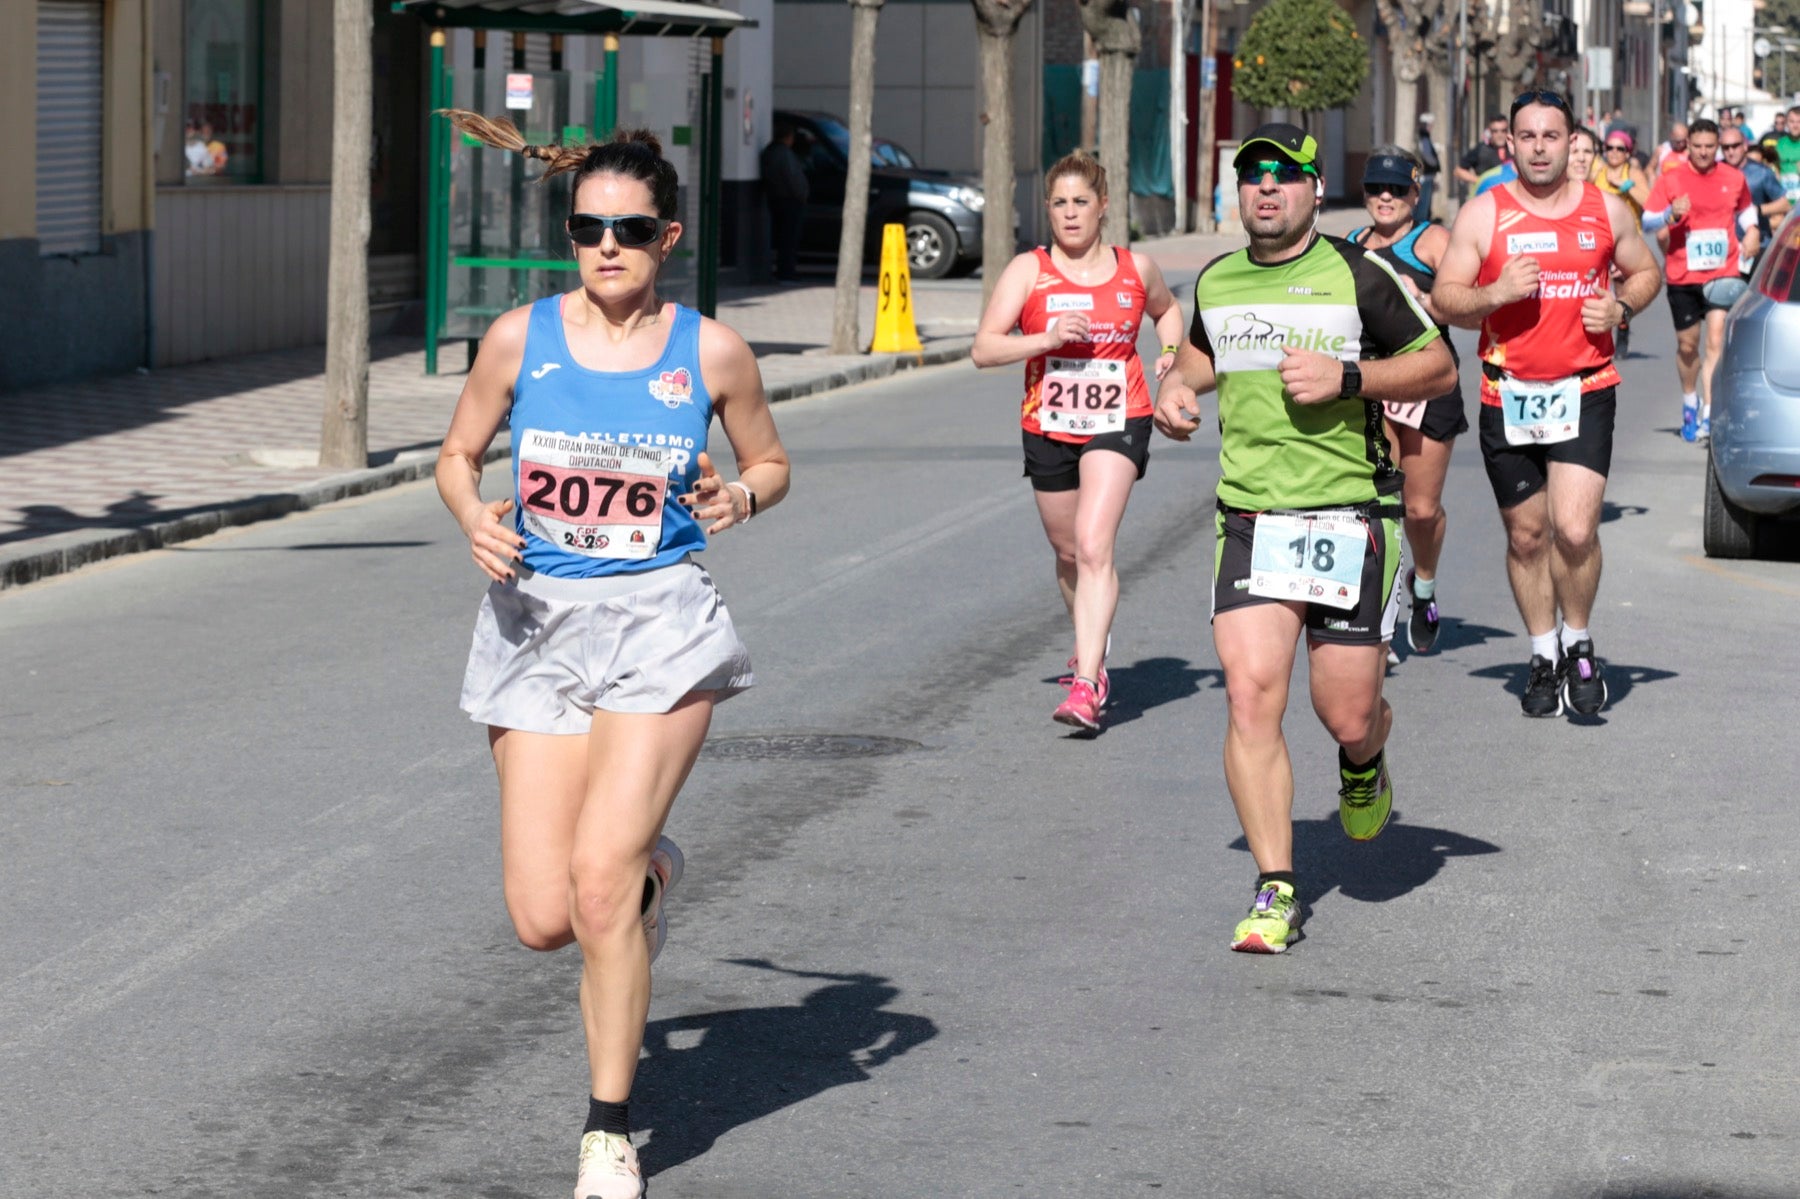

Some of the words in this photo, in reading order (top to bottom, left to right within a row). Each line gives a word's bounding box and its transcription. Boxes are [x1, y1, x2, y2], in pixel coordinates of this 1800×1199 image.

[1695, 243, 1723, 256] 130
[1047, 381, 1122, 411] 2182
[558, 439, 582, 453] GRAN
[584, 443, 617, 457] PREMIO
[619, 447, 630, 458] DE
[632, 448, 662, 462] FONDO
[526, 470, 657, 518] 2076
[1288, 535, 1336, 573] 18
